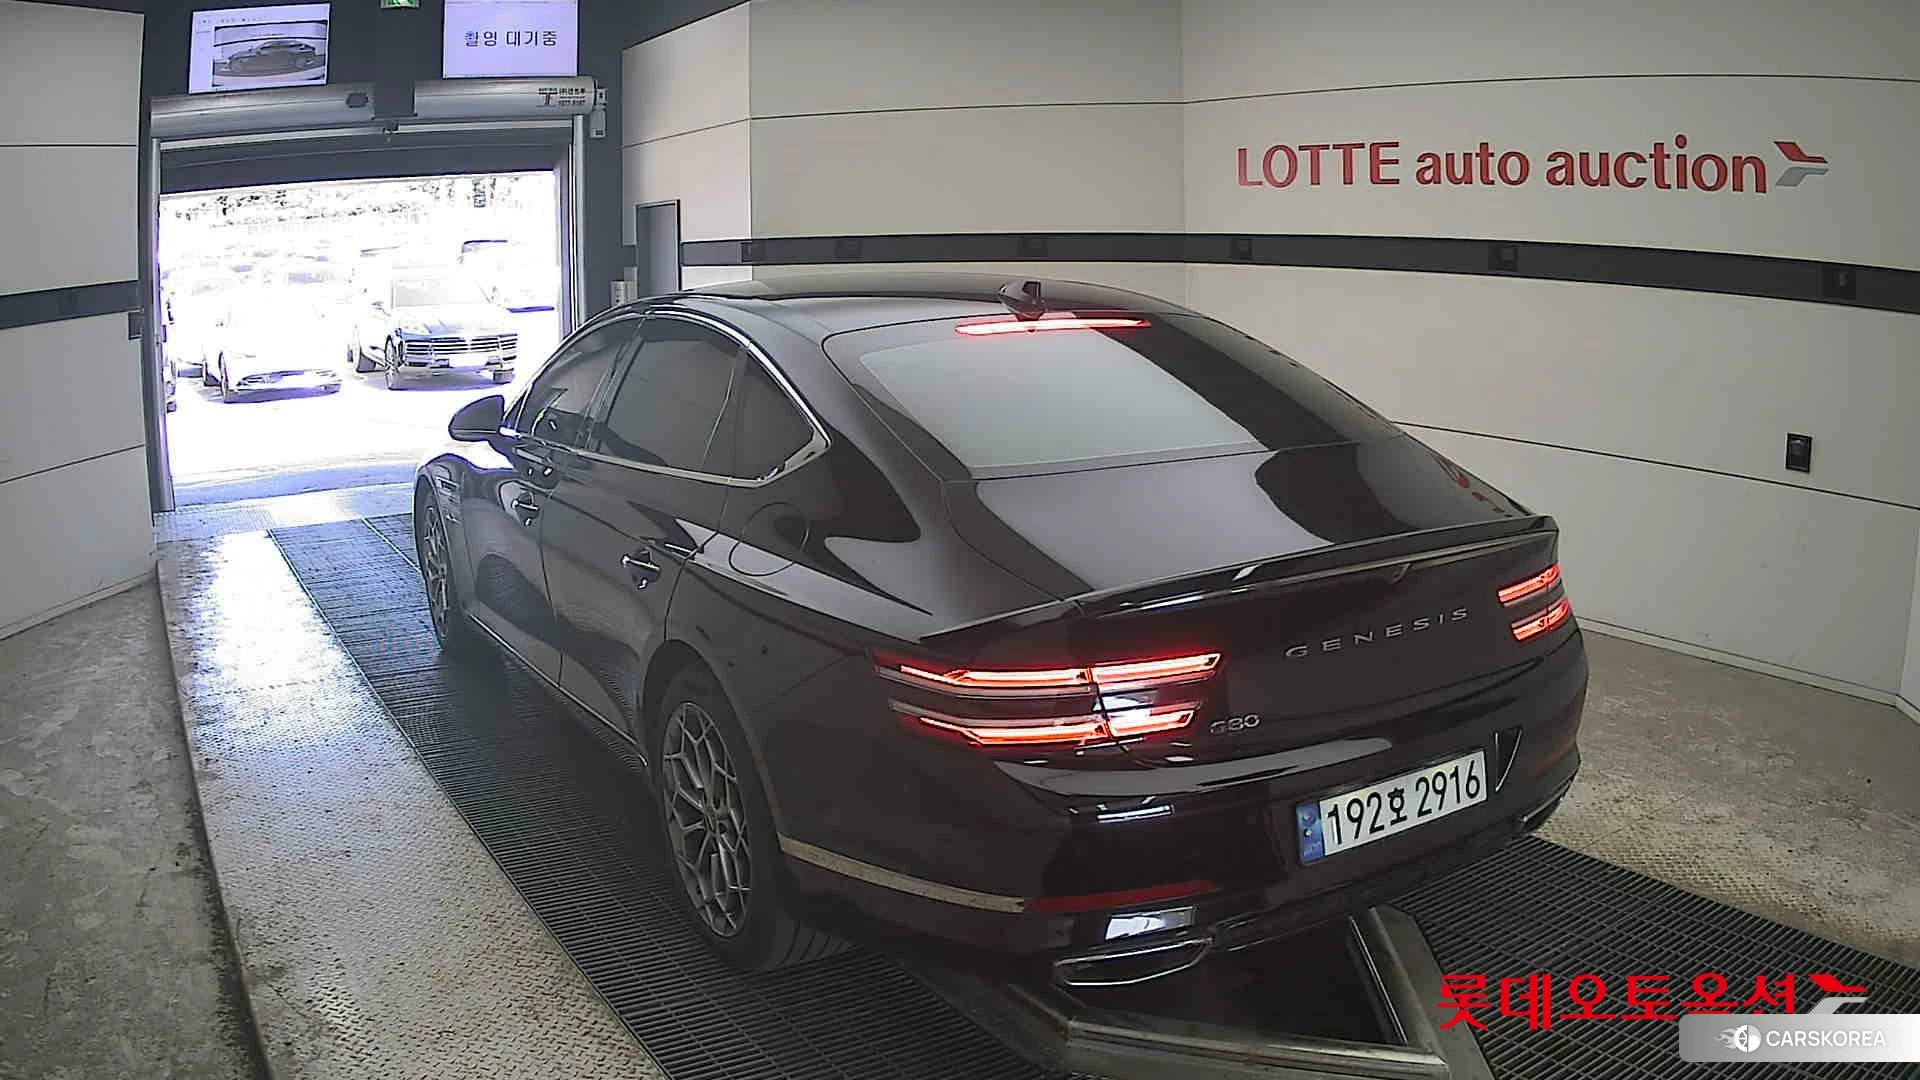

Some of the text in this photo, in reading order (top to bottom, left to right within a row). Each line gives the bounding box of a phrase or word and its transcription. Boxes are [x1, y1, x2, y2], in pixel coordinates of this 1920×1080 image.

[506, 30, 558, 47] 대기중
[1237, 134, 1767, 194] LOTTE auto auction
[1285, 607, 1468, 658] GENESIS
[1210, 713, 1261, 734] G80
[1327, 760, 1481, 845] 192호 2916
